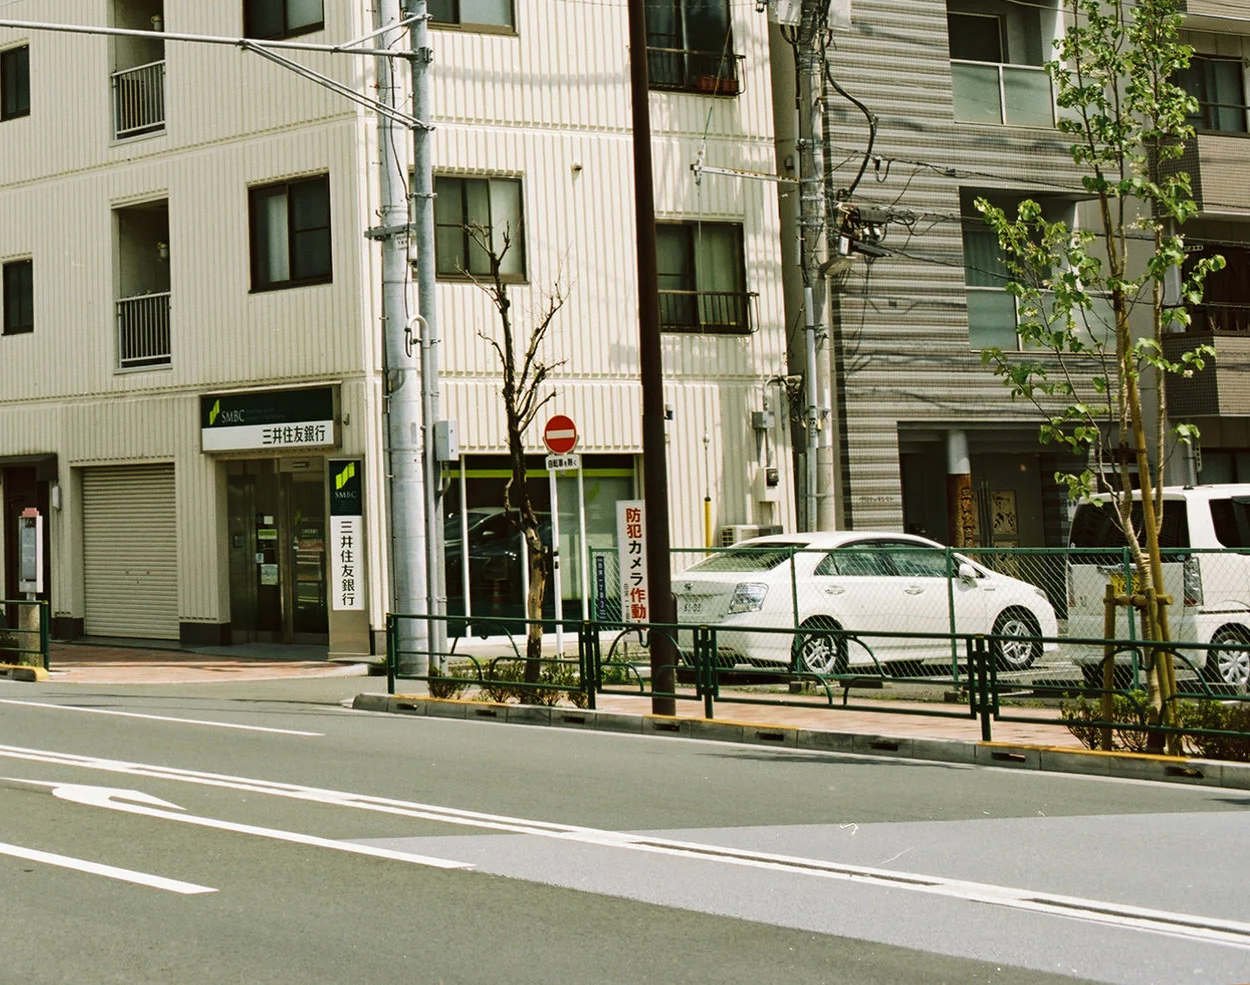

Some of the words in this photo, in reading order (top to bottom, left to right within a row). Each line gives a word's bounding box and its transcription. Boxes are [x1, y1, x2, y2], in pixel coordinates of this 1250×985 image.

[221, 409, 246, 424] SMBC
[262, 425, 326, 445] 三井住友銀行
[334, 491, 358, 499] SMBC
[340, 520, 355, 606] 三井住友銀行
[625, 507, 647, 631] 防犯カメラ作動
